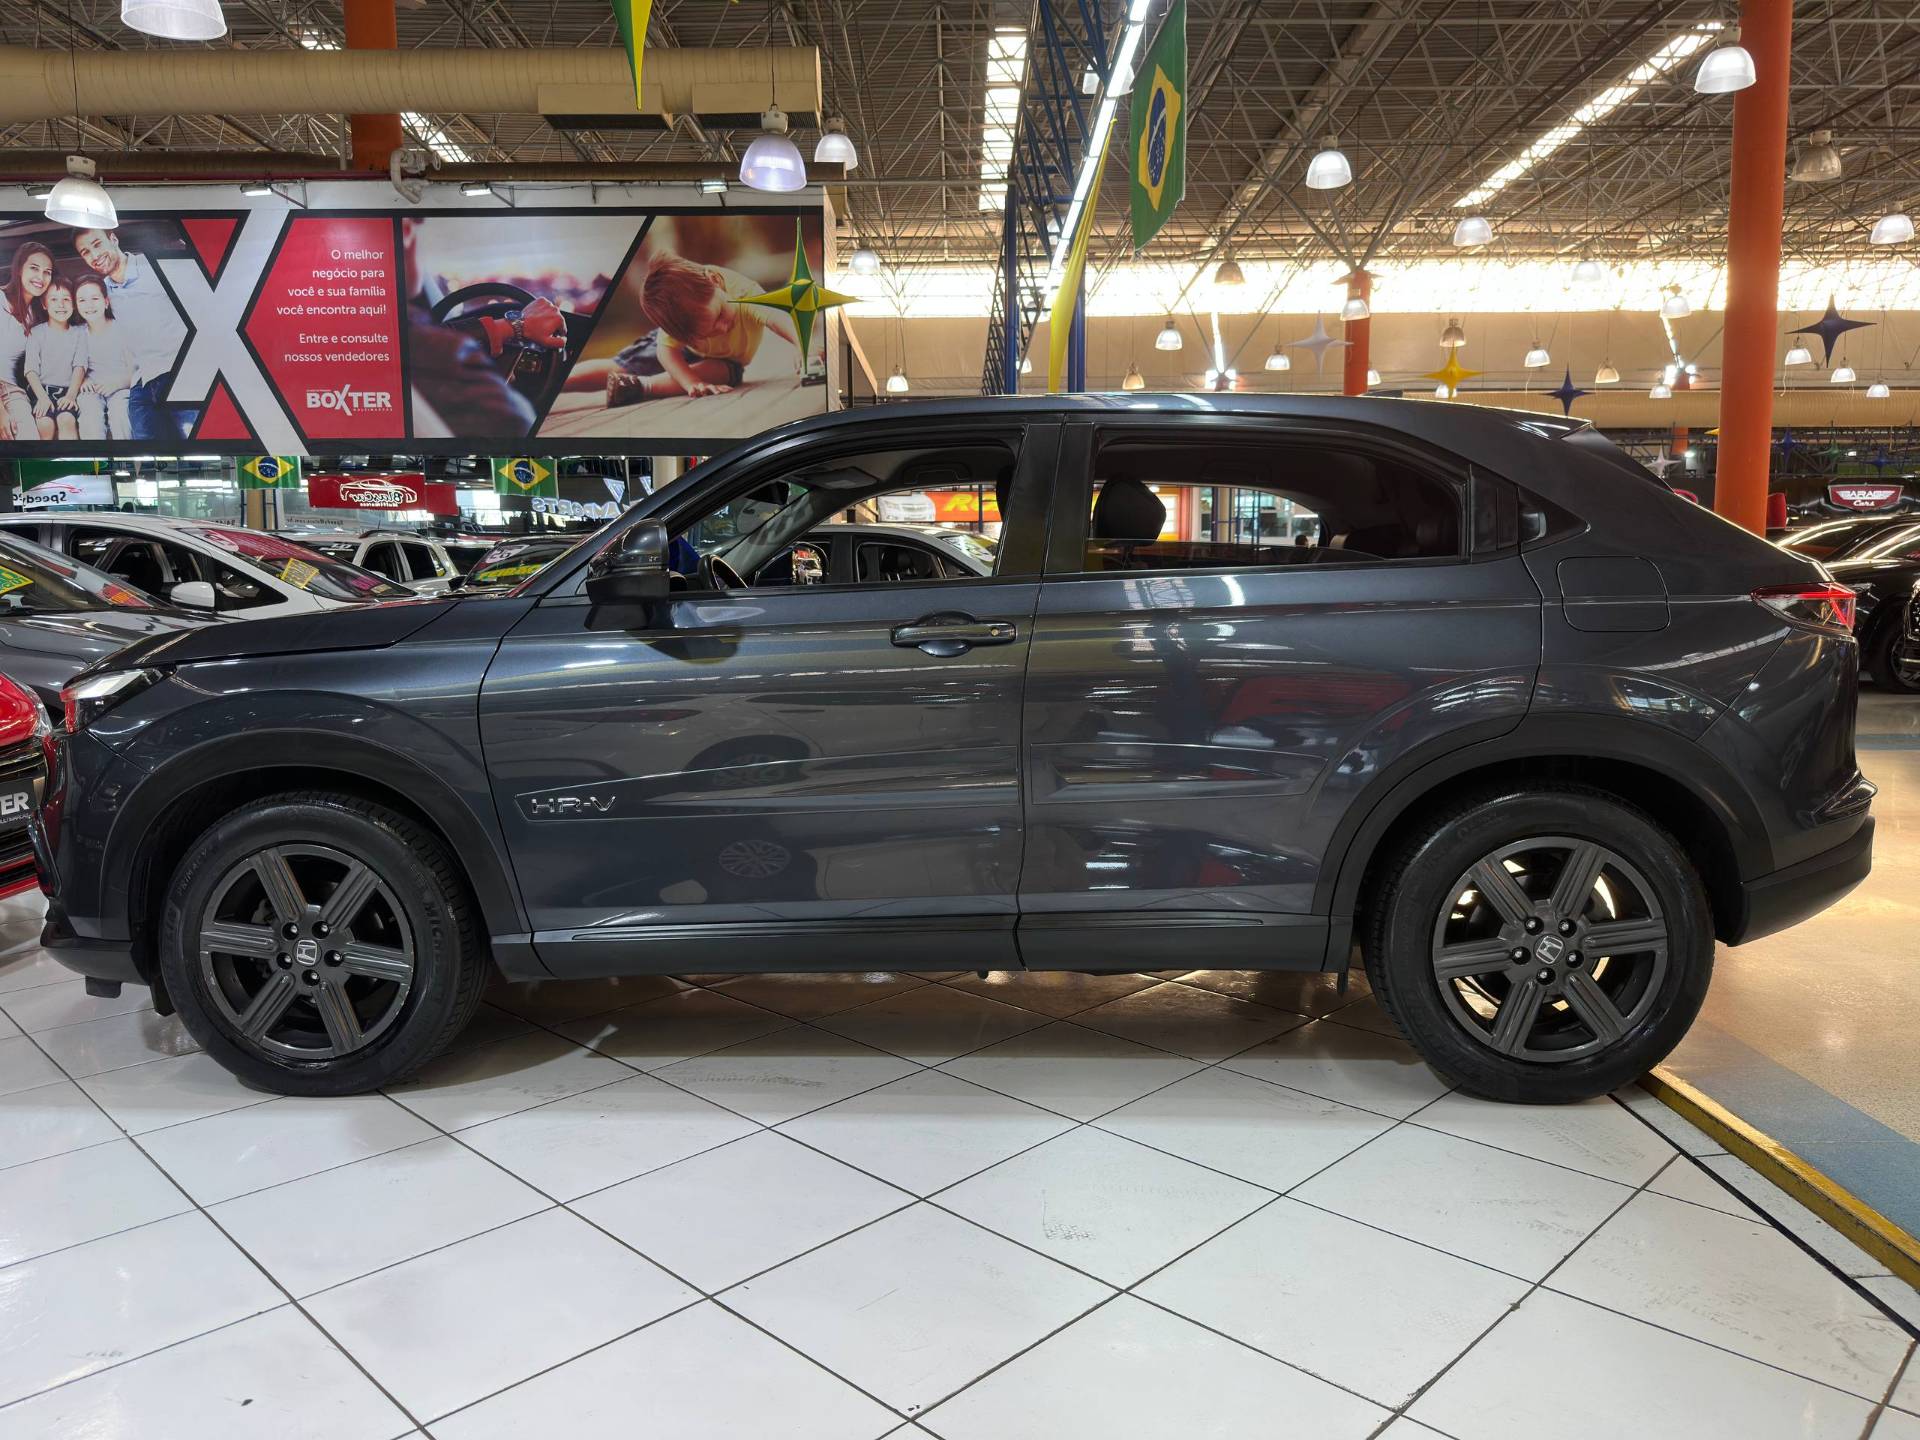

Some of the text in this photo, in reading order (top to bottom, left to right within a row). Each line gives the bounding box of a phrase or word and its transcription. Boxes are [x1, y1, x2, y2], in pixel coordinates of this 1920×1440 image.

[331, 249, 384, 260] O melhor
[312, 268, 385, 280] negócio para
[287, 286, 386, 297] você e sua família
[276, 304, 387, 317] você encontra aqui!
[299, 333, 389, 344] Entre e consulte
[284, 352, 390, 362] nossos vendedores
[306, 384, 392, 416] BOXTER
[0, 791, 30, 815] ER
[531, 795, 616, 814] HR-V
